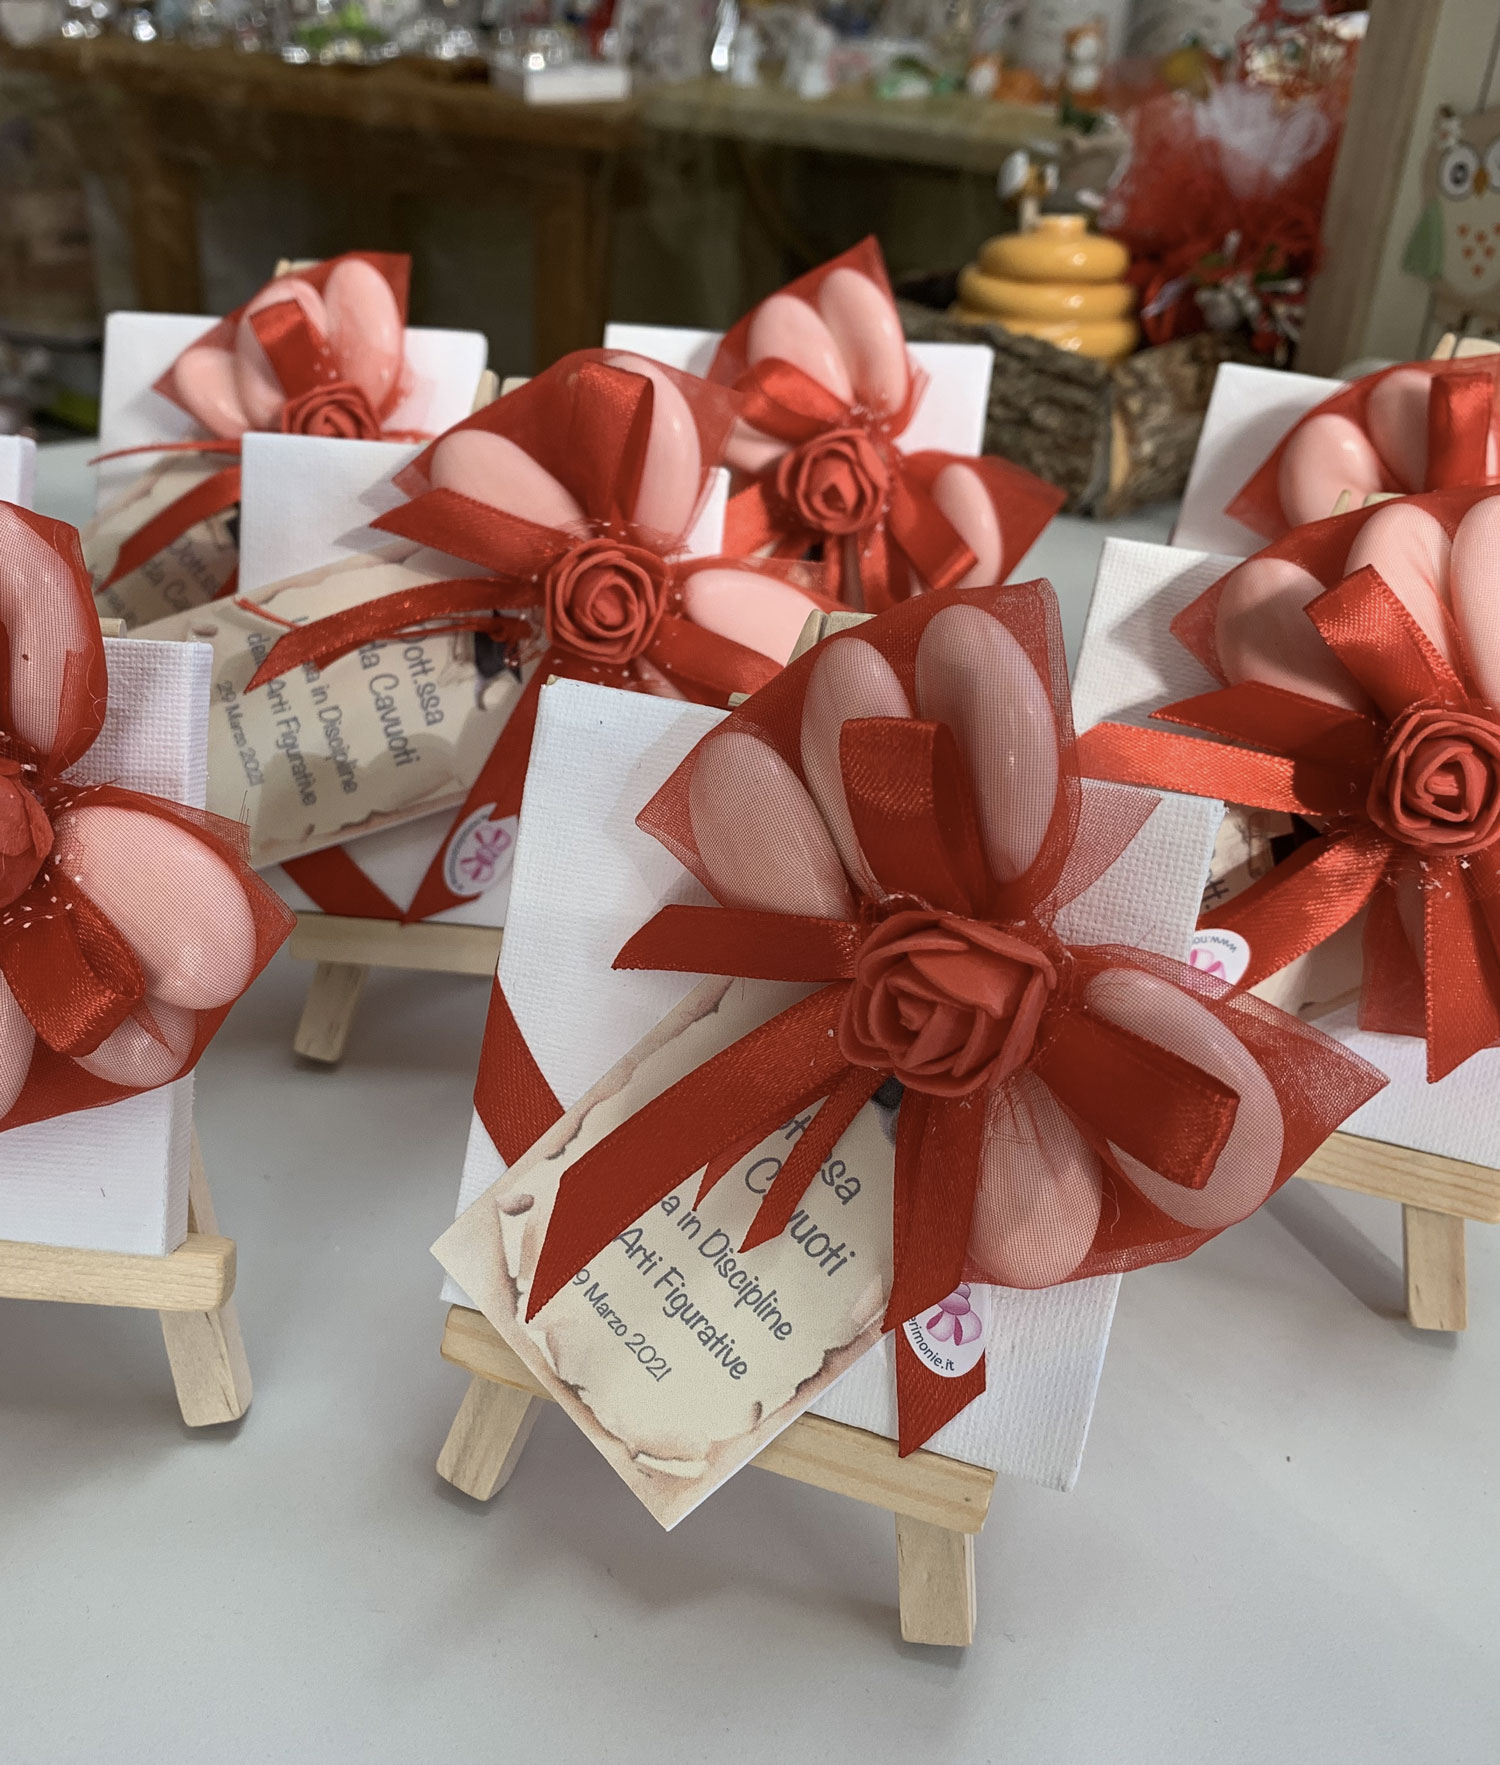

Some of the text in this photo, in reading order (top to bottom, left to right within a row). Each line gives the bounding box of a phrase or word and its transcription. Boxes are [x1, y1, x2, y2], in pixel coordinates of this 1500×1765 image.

[217, 680, 265, 787] 29 Marzo 2021
[267, 678, 293, 716] Arti
[311, 684, 331, 706] in
[369, 673, 421, 767] Cavuoti
[275, 715, 318, 806] Figurative
[318, 705, 358, 794] Discipline
[745, 1157, 857, 1278] Cuoti
[614, 1227, 748, 1380] Arti Figurative
[676, 1211, 793, 1341] in Discipline
[583, 1281, 628, 1337] Marzo
[624, 1332, 673, 1383] 2021
[908, 1316, 955, 1371] erimonie.it
